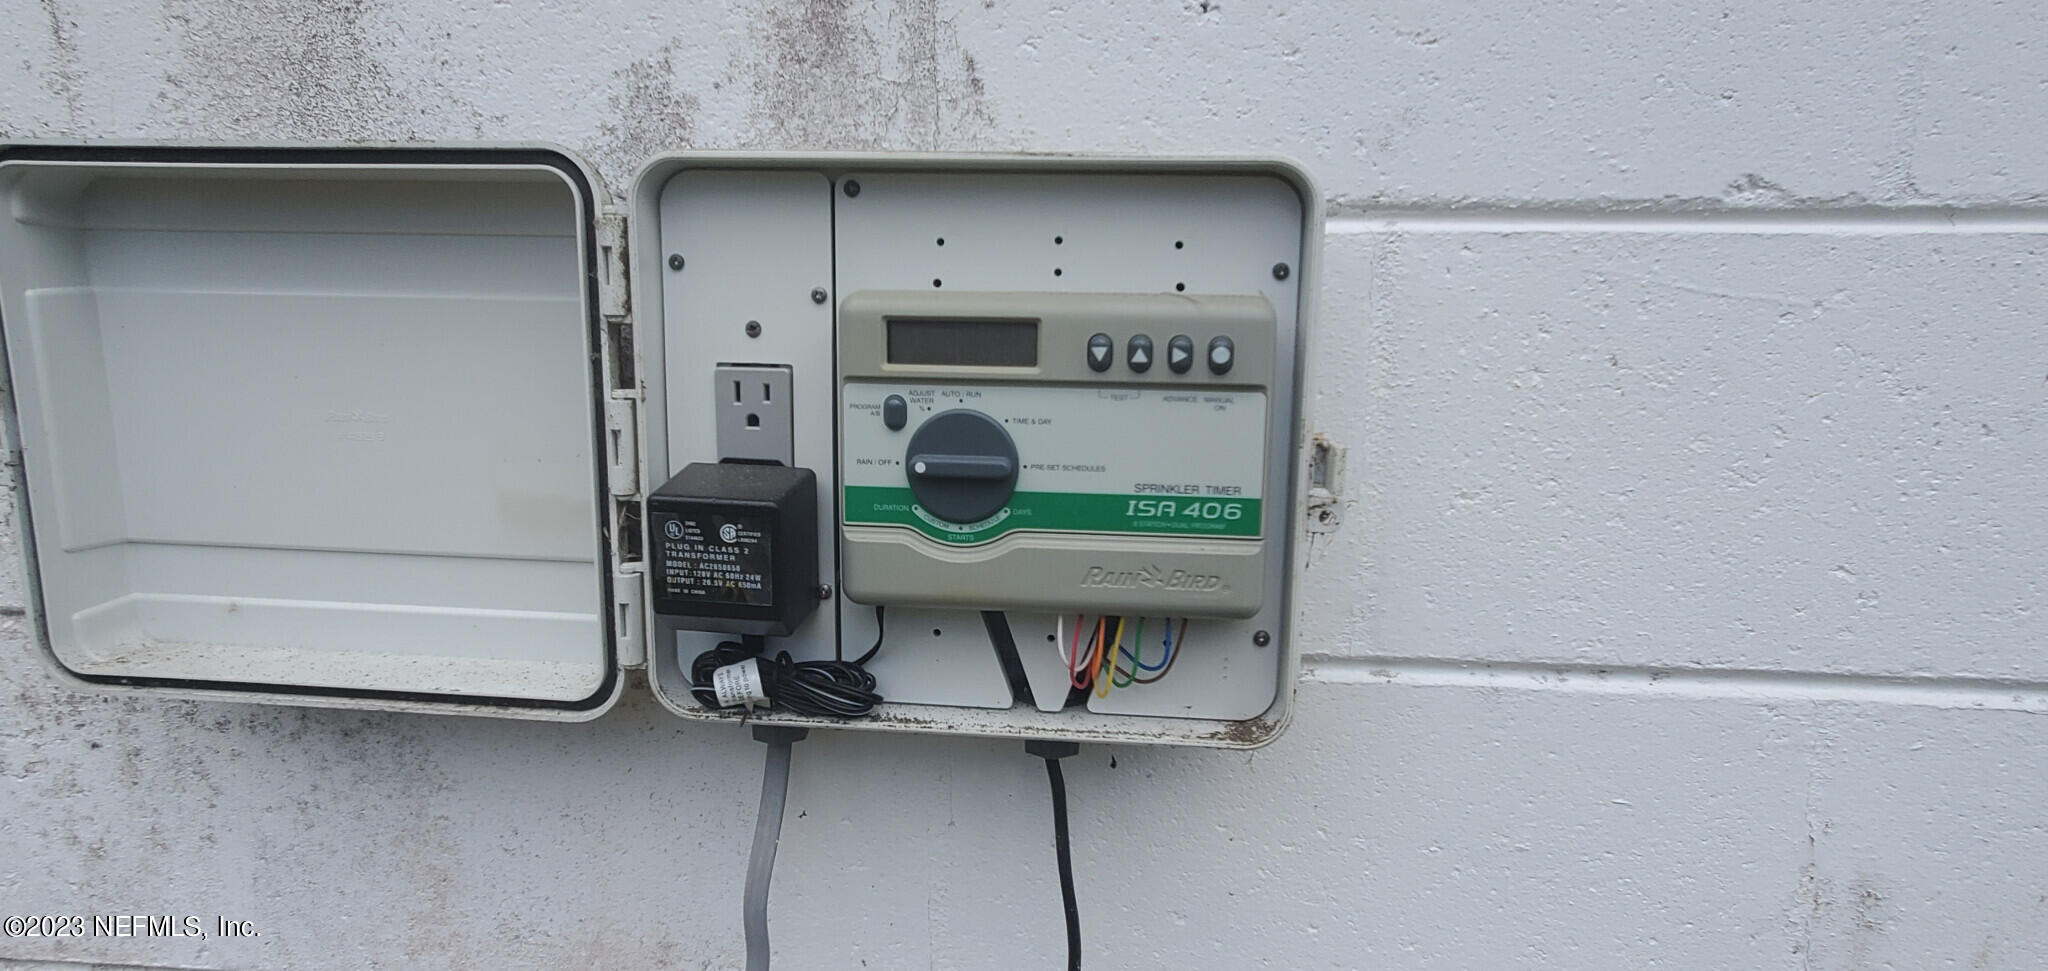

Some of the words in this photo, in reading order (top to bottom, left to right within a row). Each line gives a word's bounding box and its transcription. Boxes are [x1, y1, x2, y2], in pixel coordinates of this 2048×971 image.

[967, 391, 982, 399] RUN
[1163, 395, 1198, 404] ADVANCE
[1203, 397, 1234, 405] MANUAL
[1038, 418, 1052, 426] DAY
[878, 459, 892, 467] OFF
[1062, 464, 1106, 473] SCHEDULES
[1134, 483, 1200, 495] SPRINKLER
[1205, 485, 1241, 496] TIMER
[873, 504, 909, 512] DURATION
[1012, 508, 1032, 516] DAYS
[1126, 500, 1176, 518] ISA
[1182, 502, 1242, 520] 406
[923, 514, 950, 529] CUSTOM
[947, 533, 974, 542] STARTS
[665, 542, 691, 551] PLUG
[709, 545, 740, 554] CLASS
[665, 551, 736, 561] TRANSFORMER
[666, 560, 692, 569] MODEL
[667, 576, 694, 585] OUTPUT
[713, 571, 723, 579] AC
[725, 572, 744, 580] 60Hz
[745, 573, 762, 582] 24W
[1164, 568, 1222, 592] BIRD
